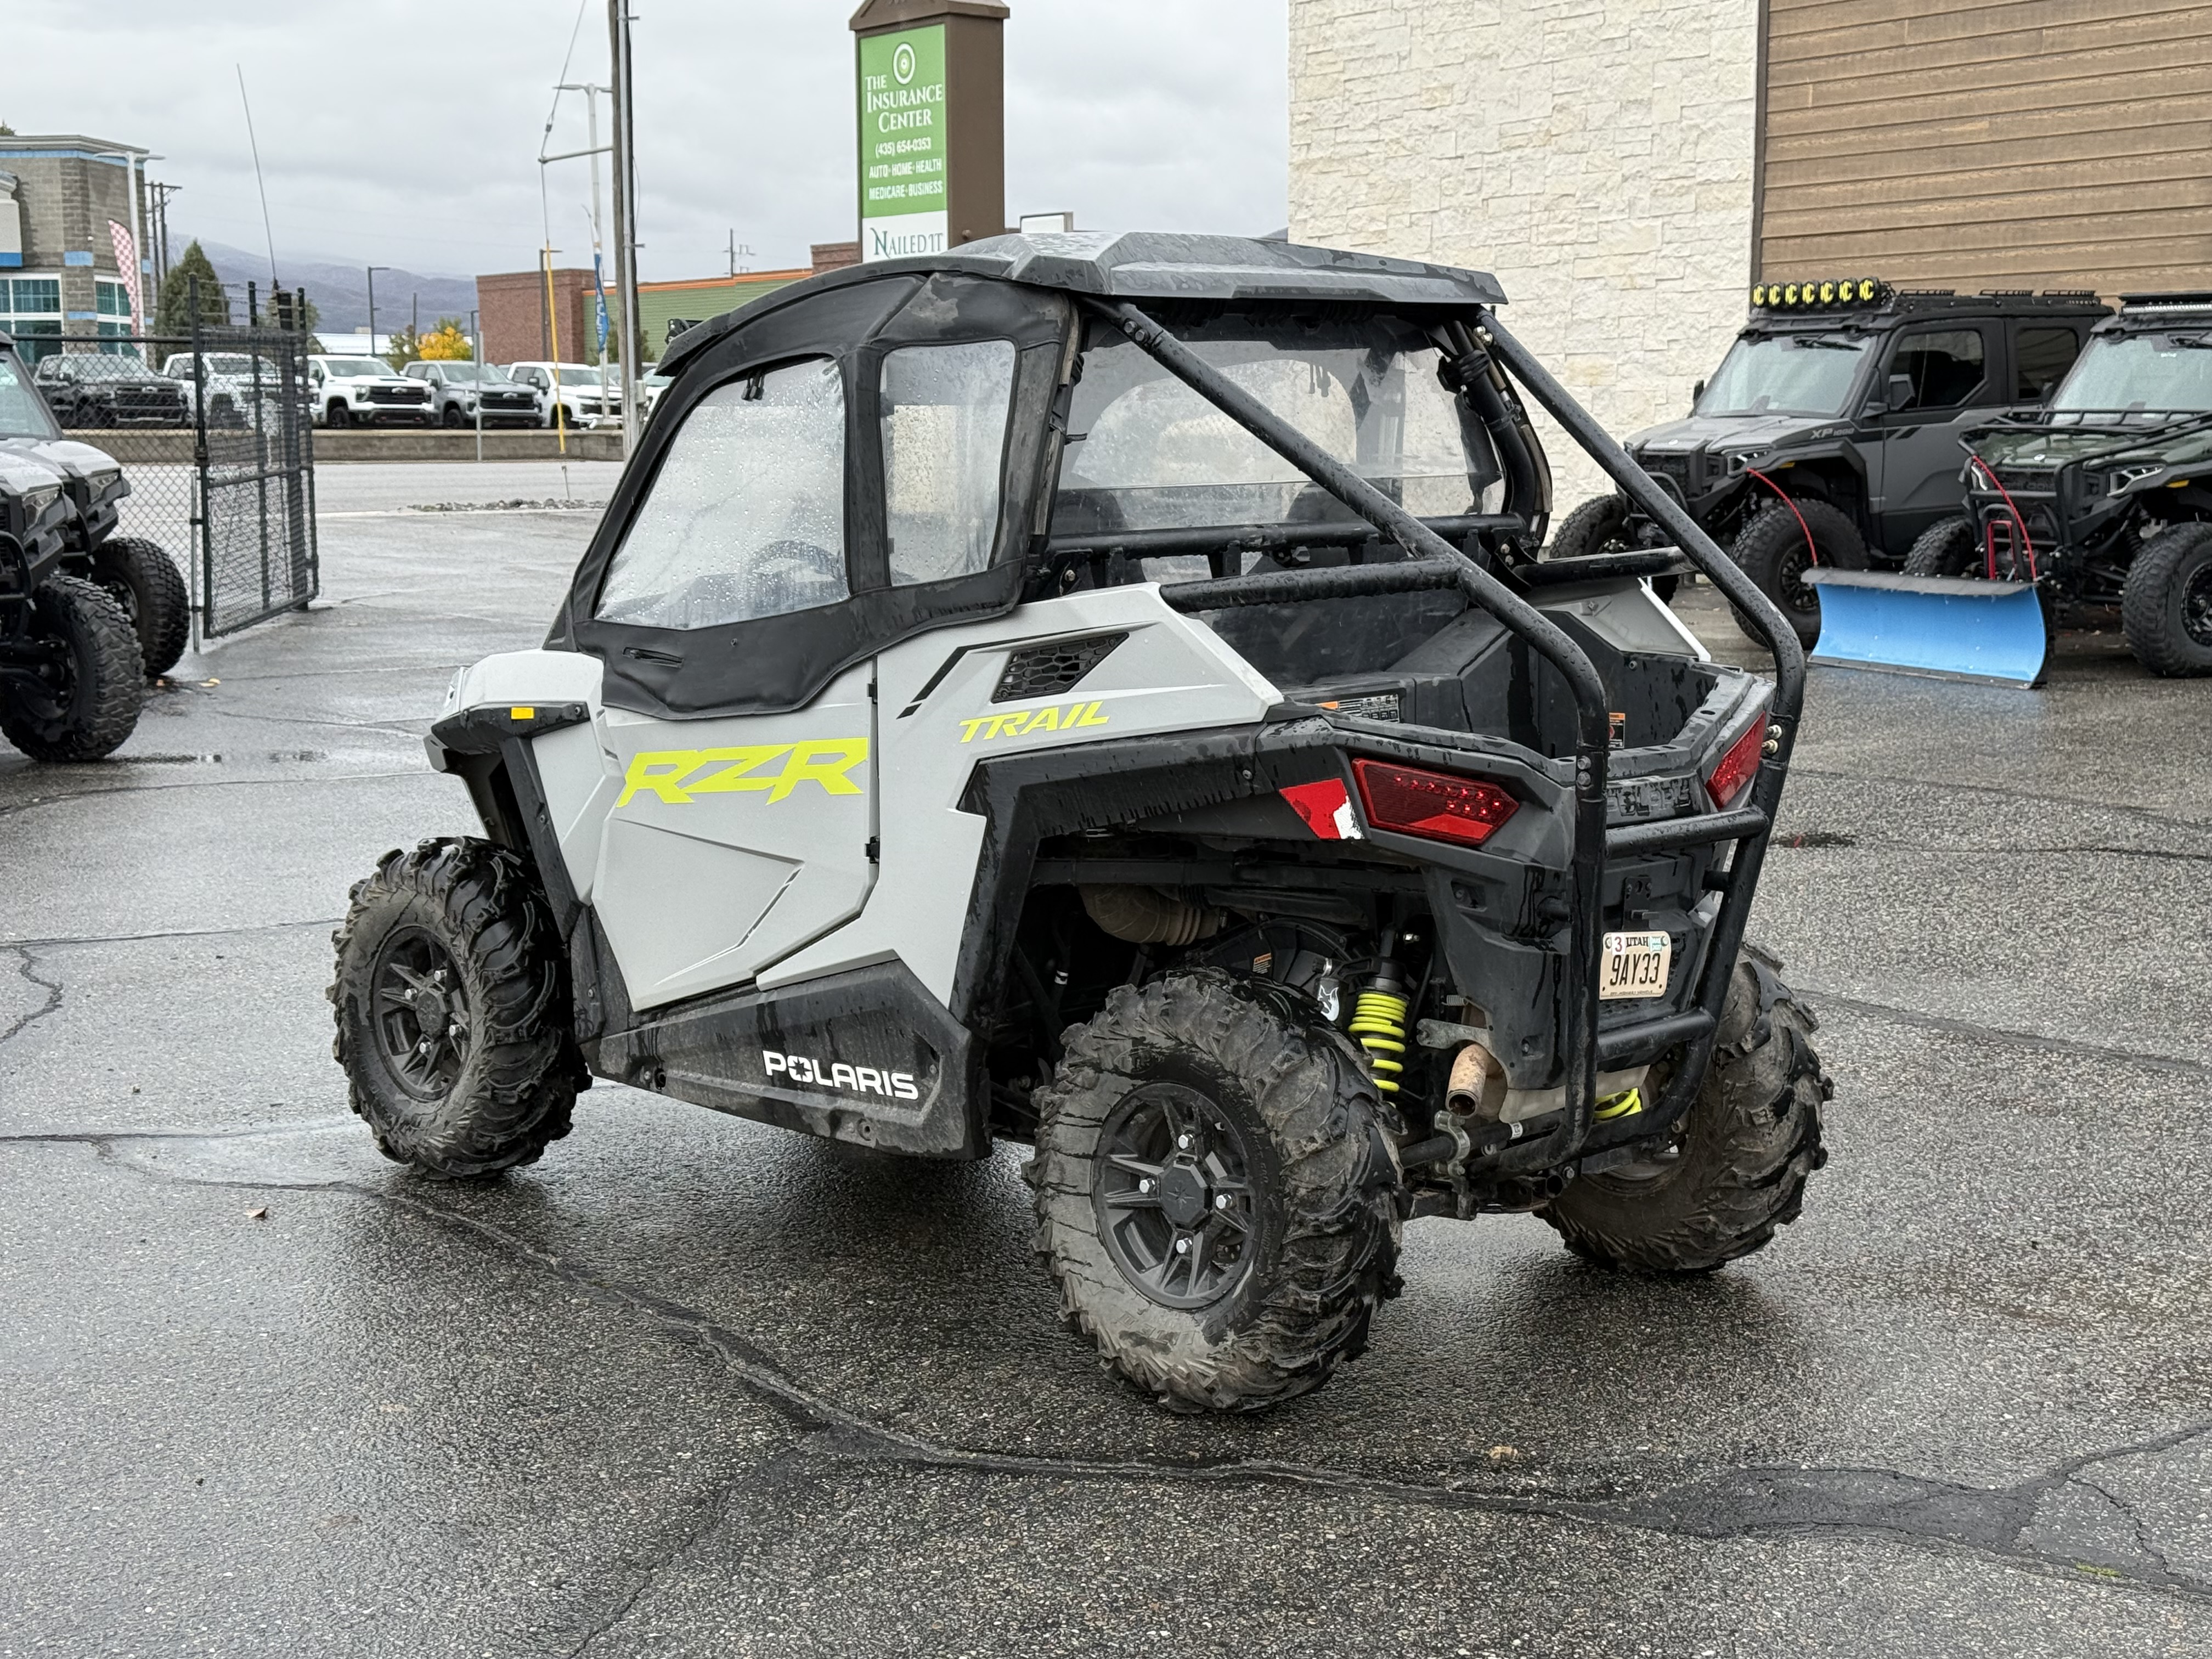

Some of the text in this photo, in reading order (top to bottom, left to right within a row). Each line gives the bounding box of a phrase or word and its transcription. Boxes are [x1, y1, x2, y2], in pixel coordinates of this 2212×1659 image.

[865, 75, 887, 91] THE
[867, 83, 943, 113] INSURANCE
[878, 108, 933, 133] CENTER
[875, 142, 895, 159] (435)
[1810, 428, 1833, 439] XP
[959, 701, 1110, 743] TRAIL
[616, 737, 868, 808] RZR
[1626, 936, 1649, 947] UTAH
[1610, 953, 1661, 986] 9AY33
[763, 1050, 918, 1100] POLARIS
